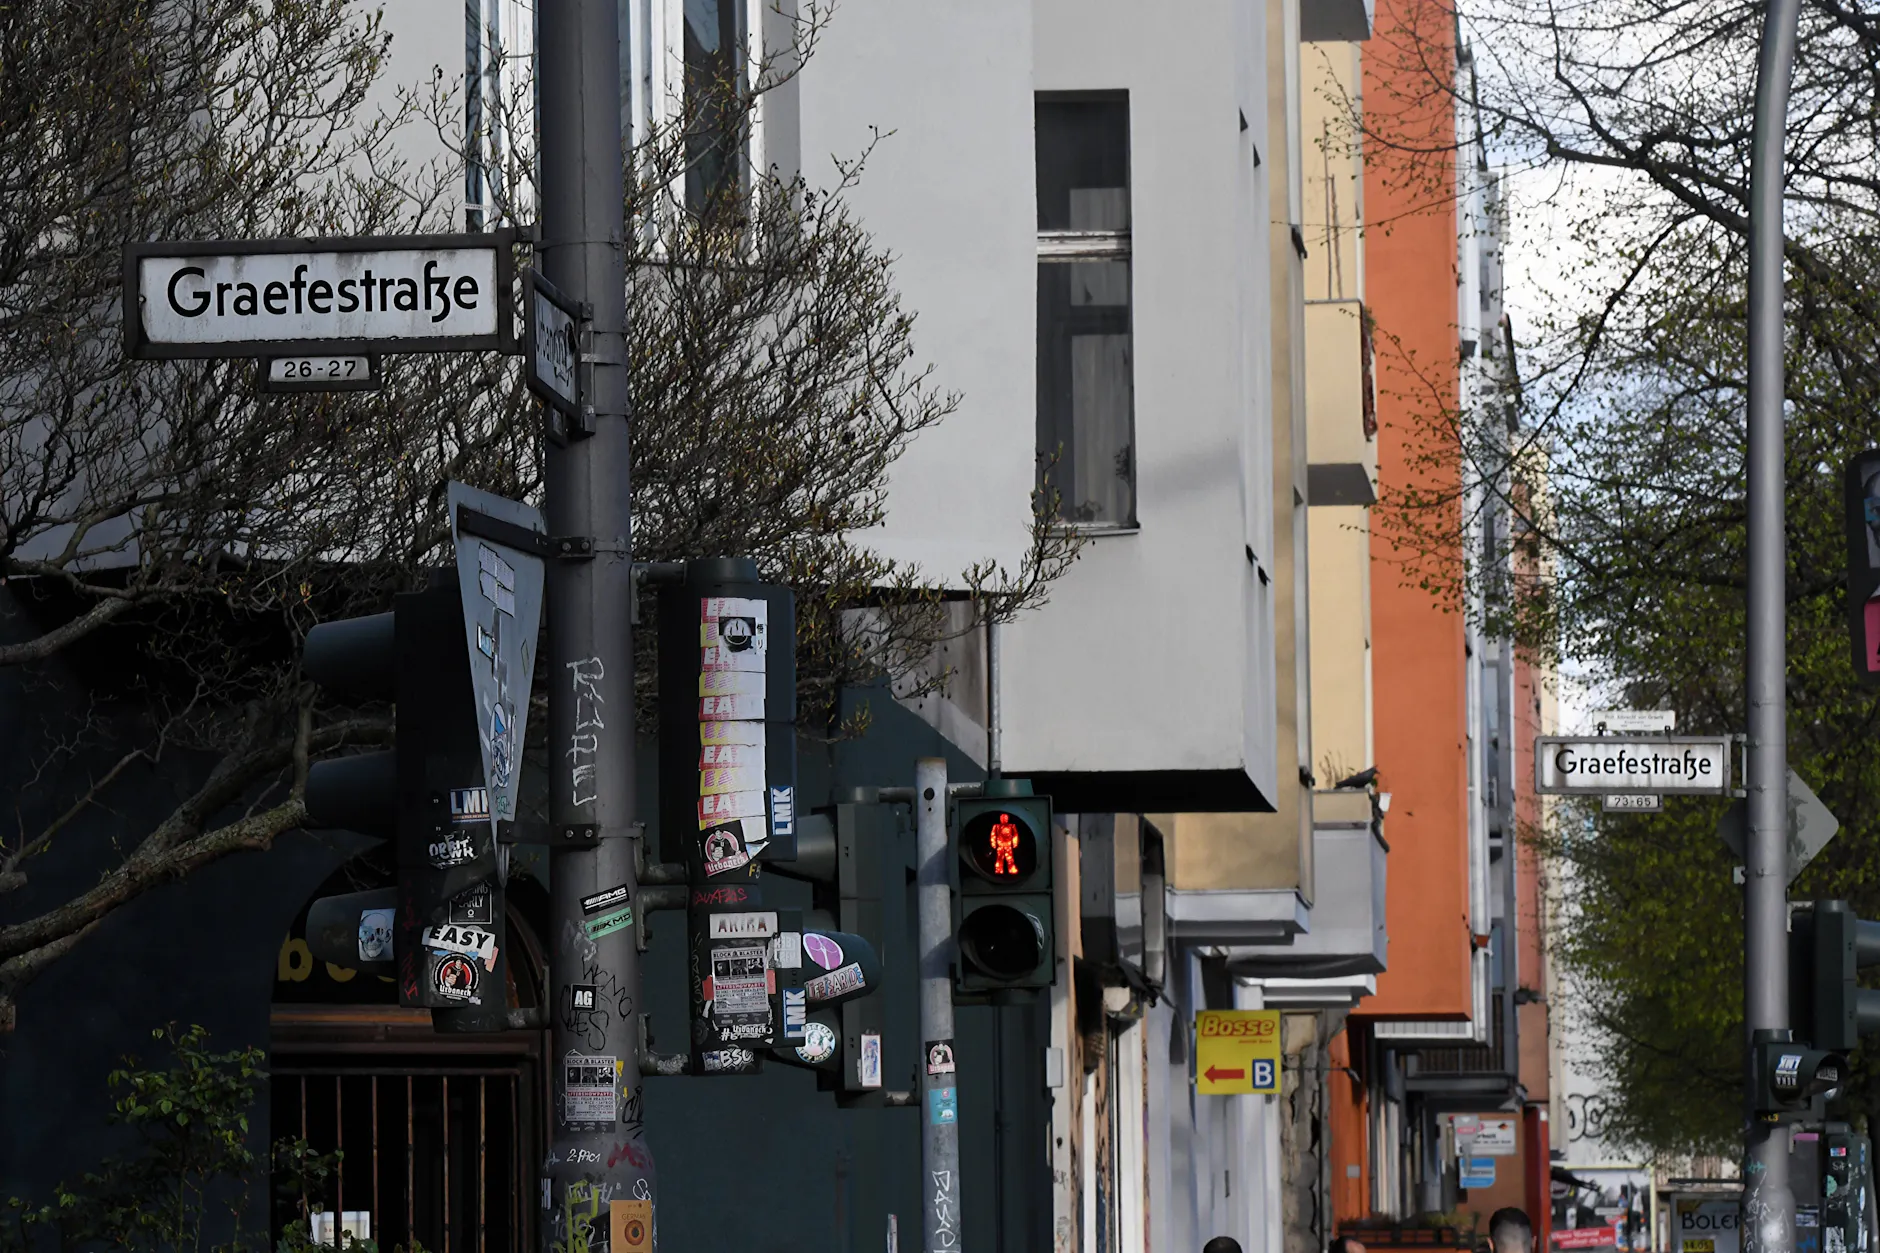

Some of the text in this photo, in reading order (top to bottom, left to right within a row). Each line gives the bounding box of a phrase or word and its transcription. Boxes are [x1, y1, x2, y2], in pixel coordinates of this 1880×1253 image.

[167, 260, 479, 324] Graefestraße
[283, 360, 357, 378] 26-27
[1555, 749, 1712, 780] Graefestraße
[772, 787, 792, 835] LMK
[1614, 796, 1651, 807] 73-65
[429, 925, 490, 950] EASY
[574, 990, 593, 1006] AG
[785, 990, 806, 1038] LMK
[1201, 1015, 1275, 1038] Bosse
[1254, 1061, 1273, 1086] B
